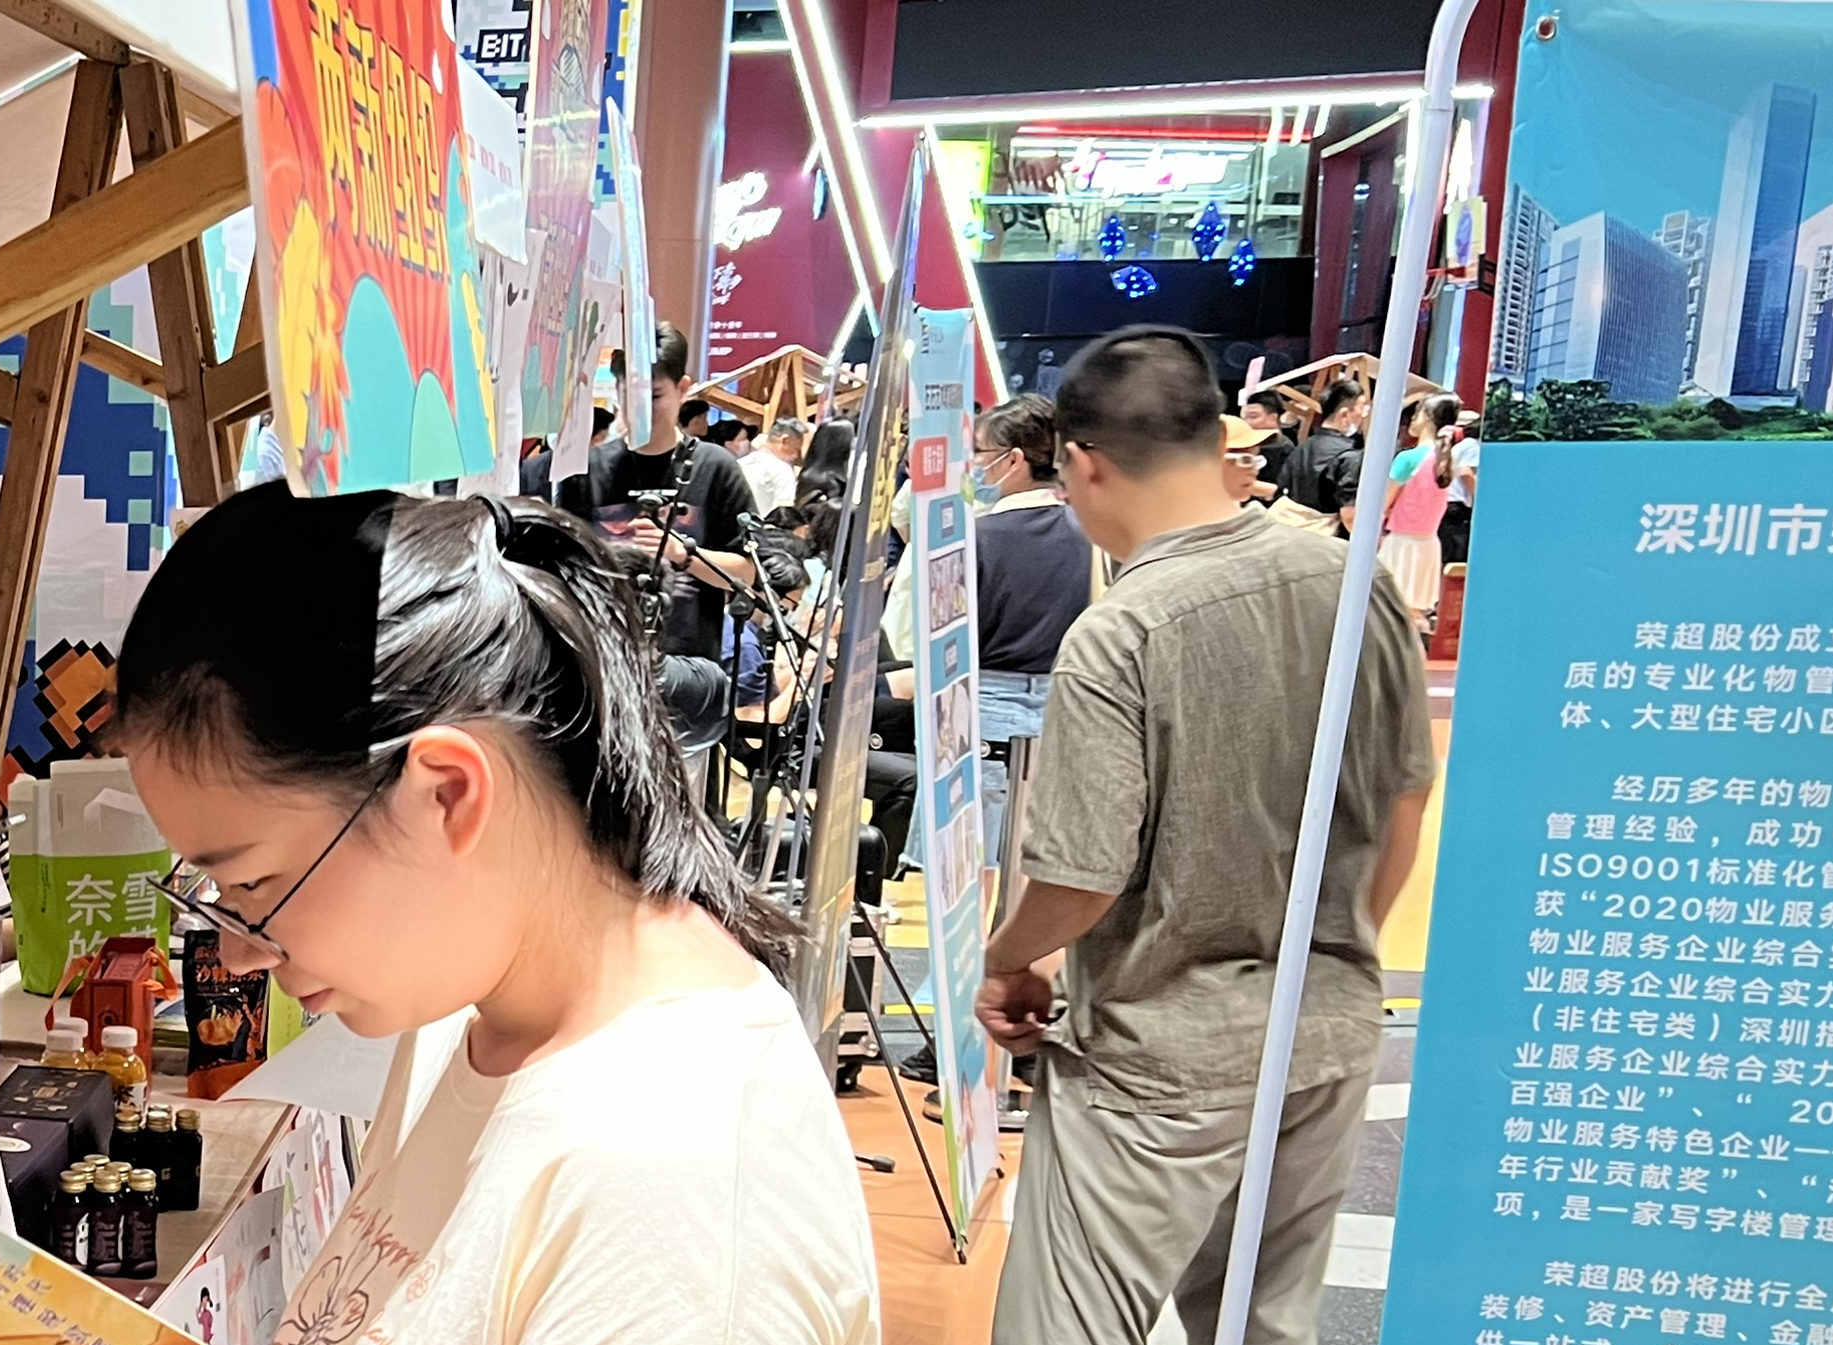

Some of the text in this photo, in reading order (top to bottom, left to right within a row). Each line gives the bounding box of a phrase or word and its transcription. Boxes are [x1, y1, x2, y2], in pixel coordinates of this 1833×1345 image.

[1635, 504, 1833, 556] 深圳市
[1635, 622, 1833, 653] 荣超股份成
[65, 870, 160, 926] 奈雪
[1529, 929, 1833, 967] 物业服务企业综合
[1498, 1153, 1833, 1204] 年行业贡献奖”、“
[1543, 1260, 1833, 1312] 荣超股份将进行全
